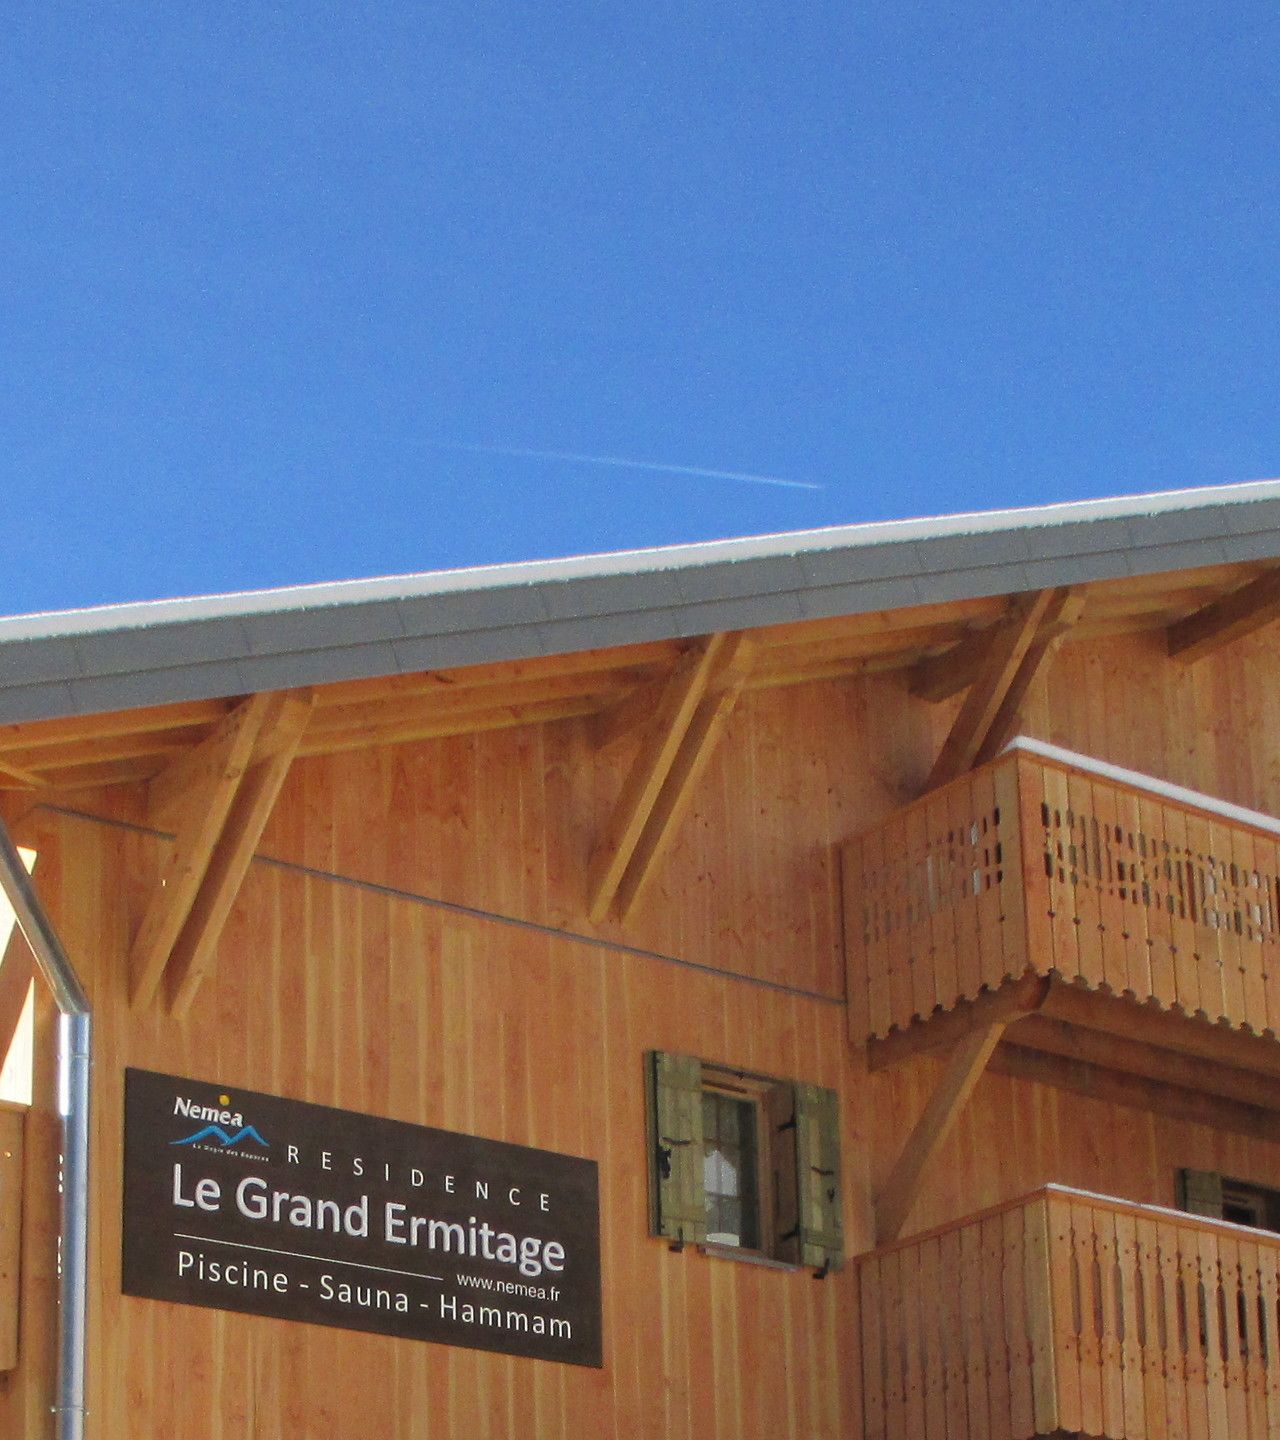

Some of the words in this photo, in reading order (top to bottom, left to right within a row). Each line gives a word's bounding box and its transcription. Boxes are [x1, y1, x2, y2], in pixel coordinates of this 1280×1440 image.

[173, 1096, 244, 1128] Nemea
[287, 1144, 550, 1212] RESIDENCE
[173, 1163, 221, 1212] Le
[236, 1176, 369, 1238] Grand
[385, 1202, 566, 1277] Ermitage
[177, 1251, 289, 1293] Piscine
[319, 1274, 410, 1313] Sauna
[439, 1293, 572, 1340] Hammam
[456, 1273, 561, 1302] www.nemea.fr
